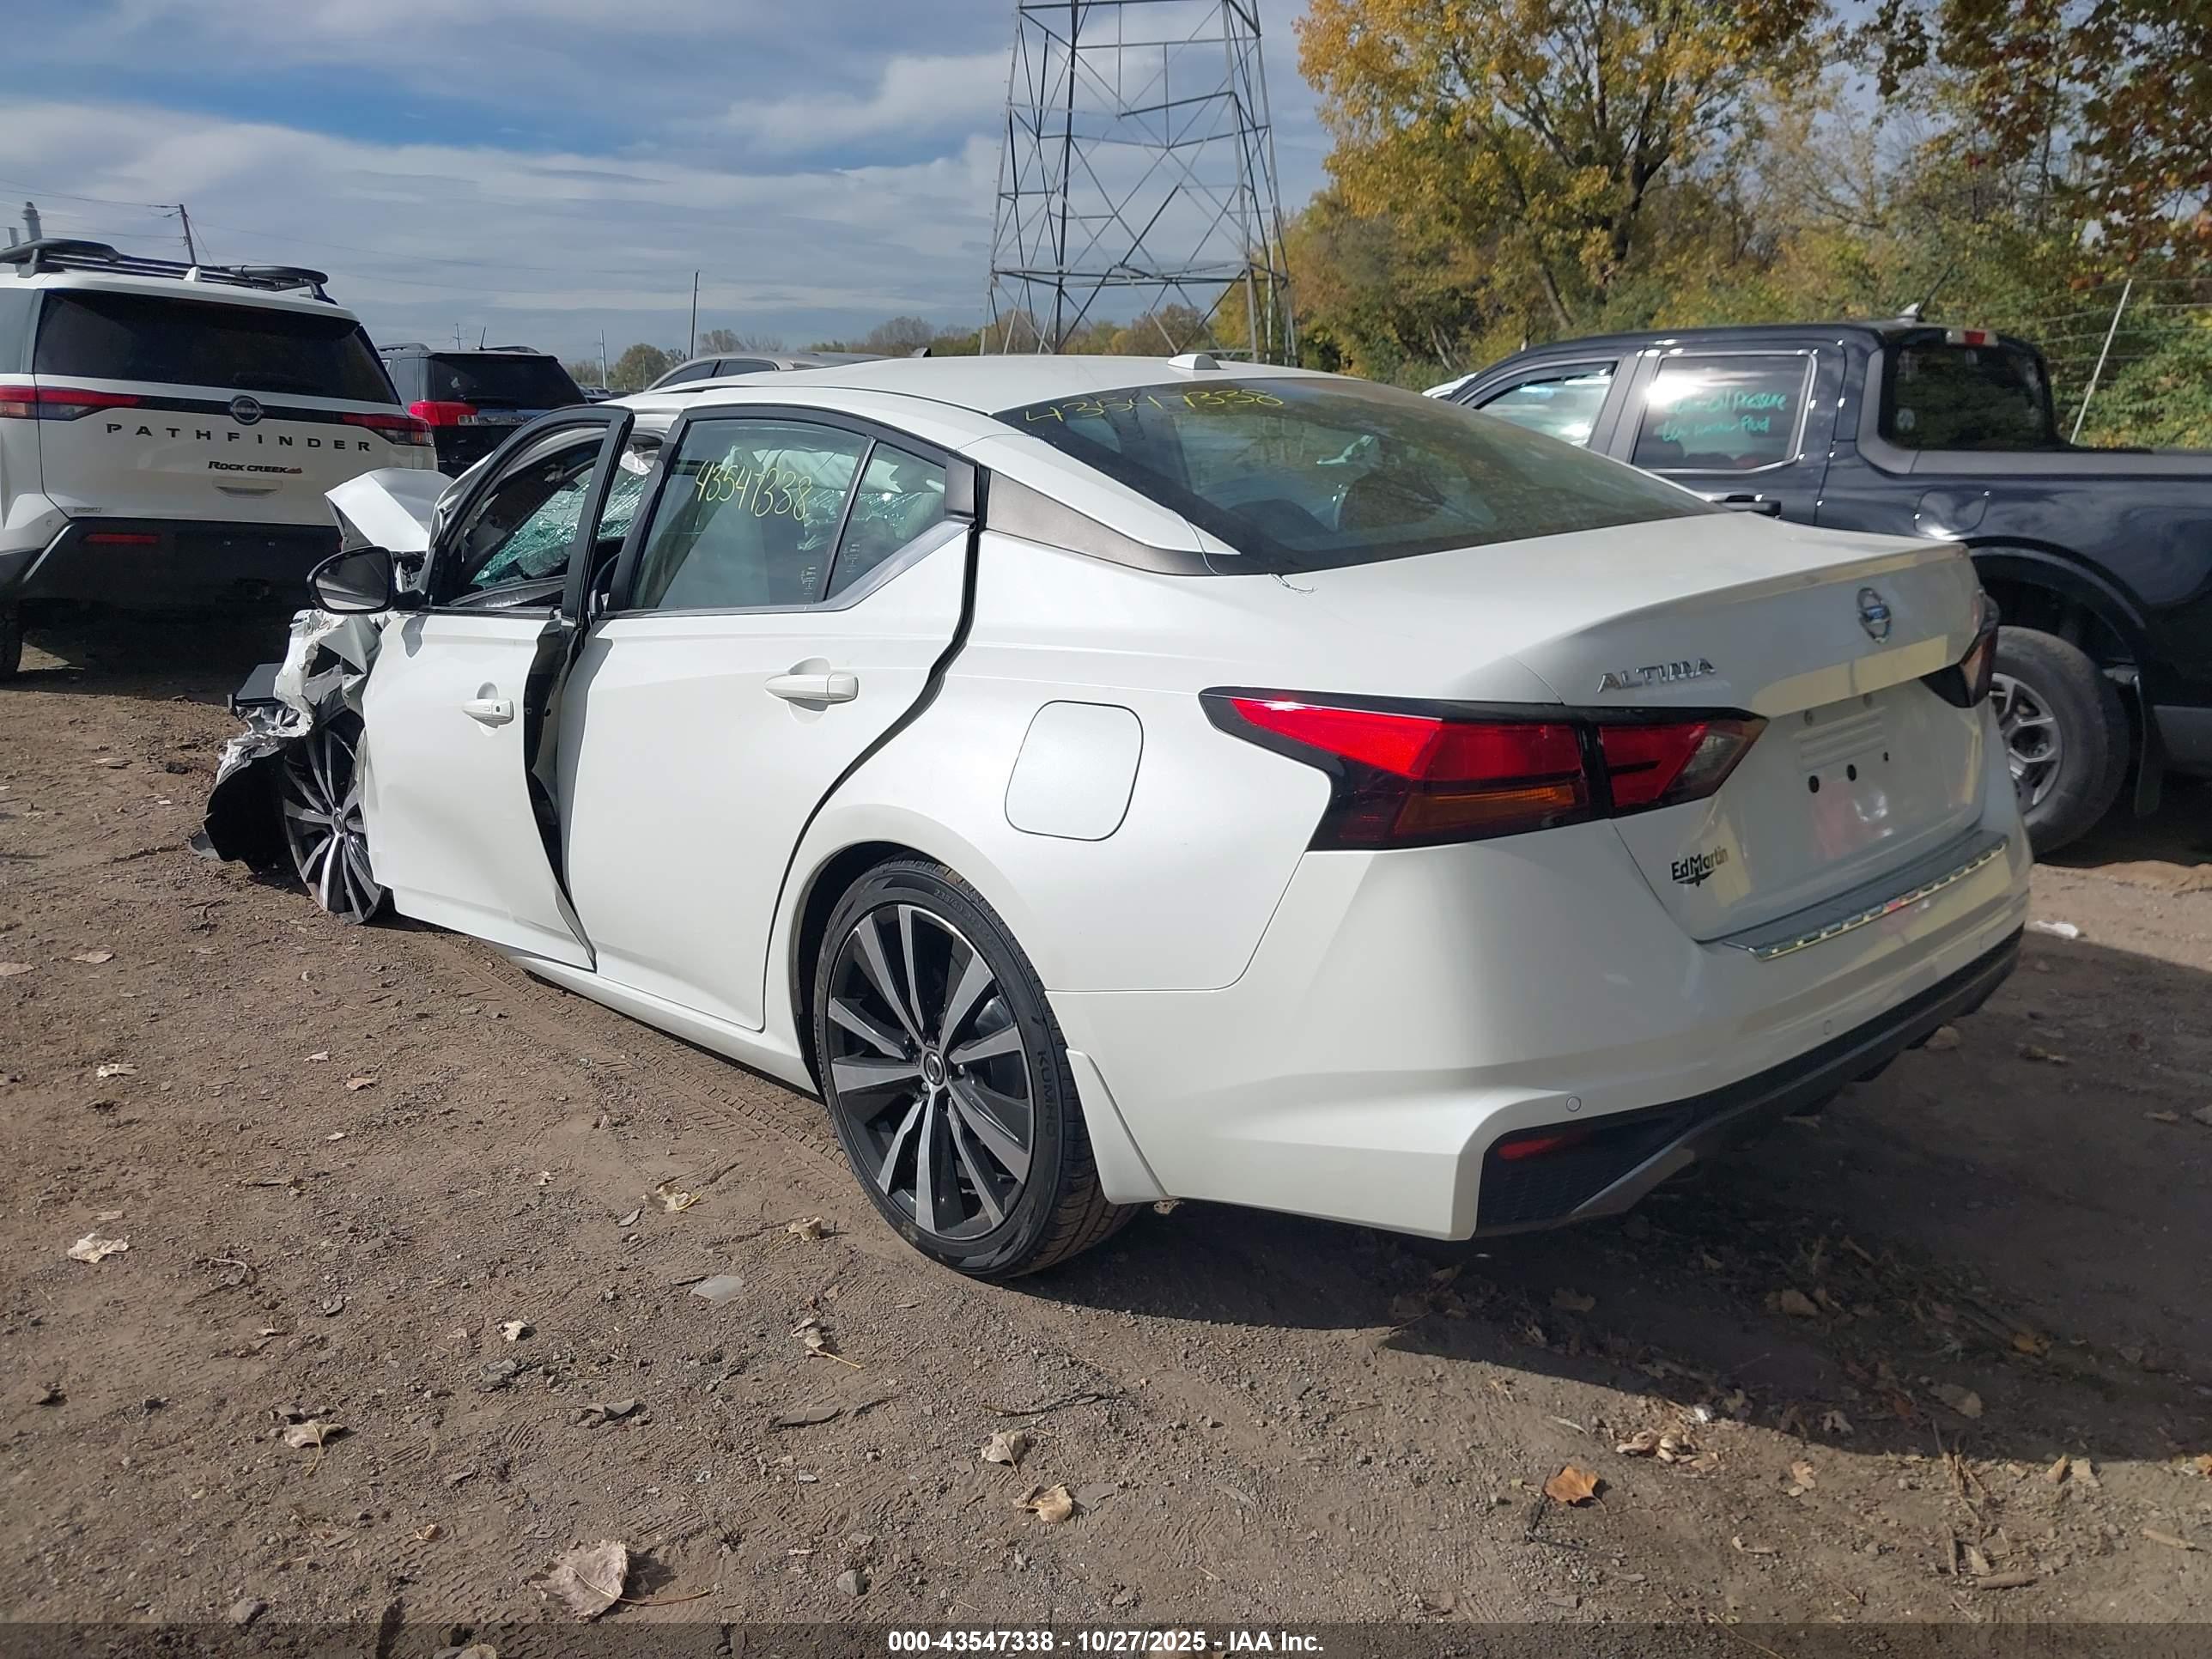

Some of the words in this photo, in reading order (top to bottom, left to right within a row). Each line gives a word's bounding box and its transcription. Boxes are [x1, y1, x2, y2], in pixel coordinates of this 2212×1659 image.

[1025, 389, 1284, 422] 43547338
[106, 423, 371, 452] PATHFINDER
[696, 459, 813, 521] 43547338
[1597, 658, 1717, 694] ALTIMA
[1036, 1050, 1056, 1138] KUMHO
